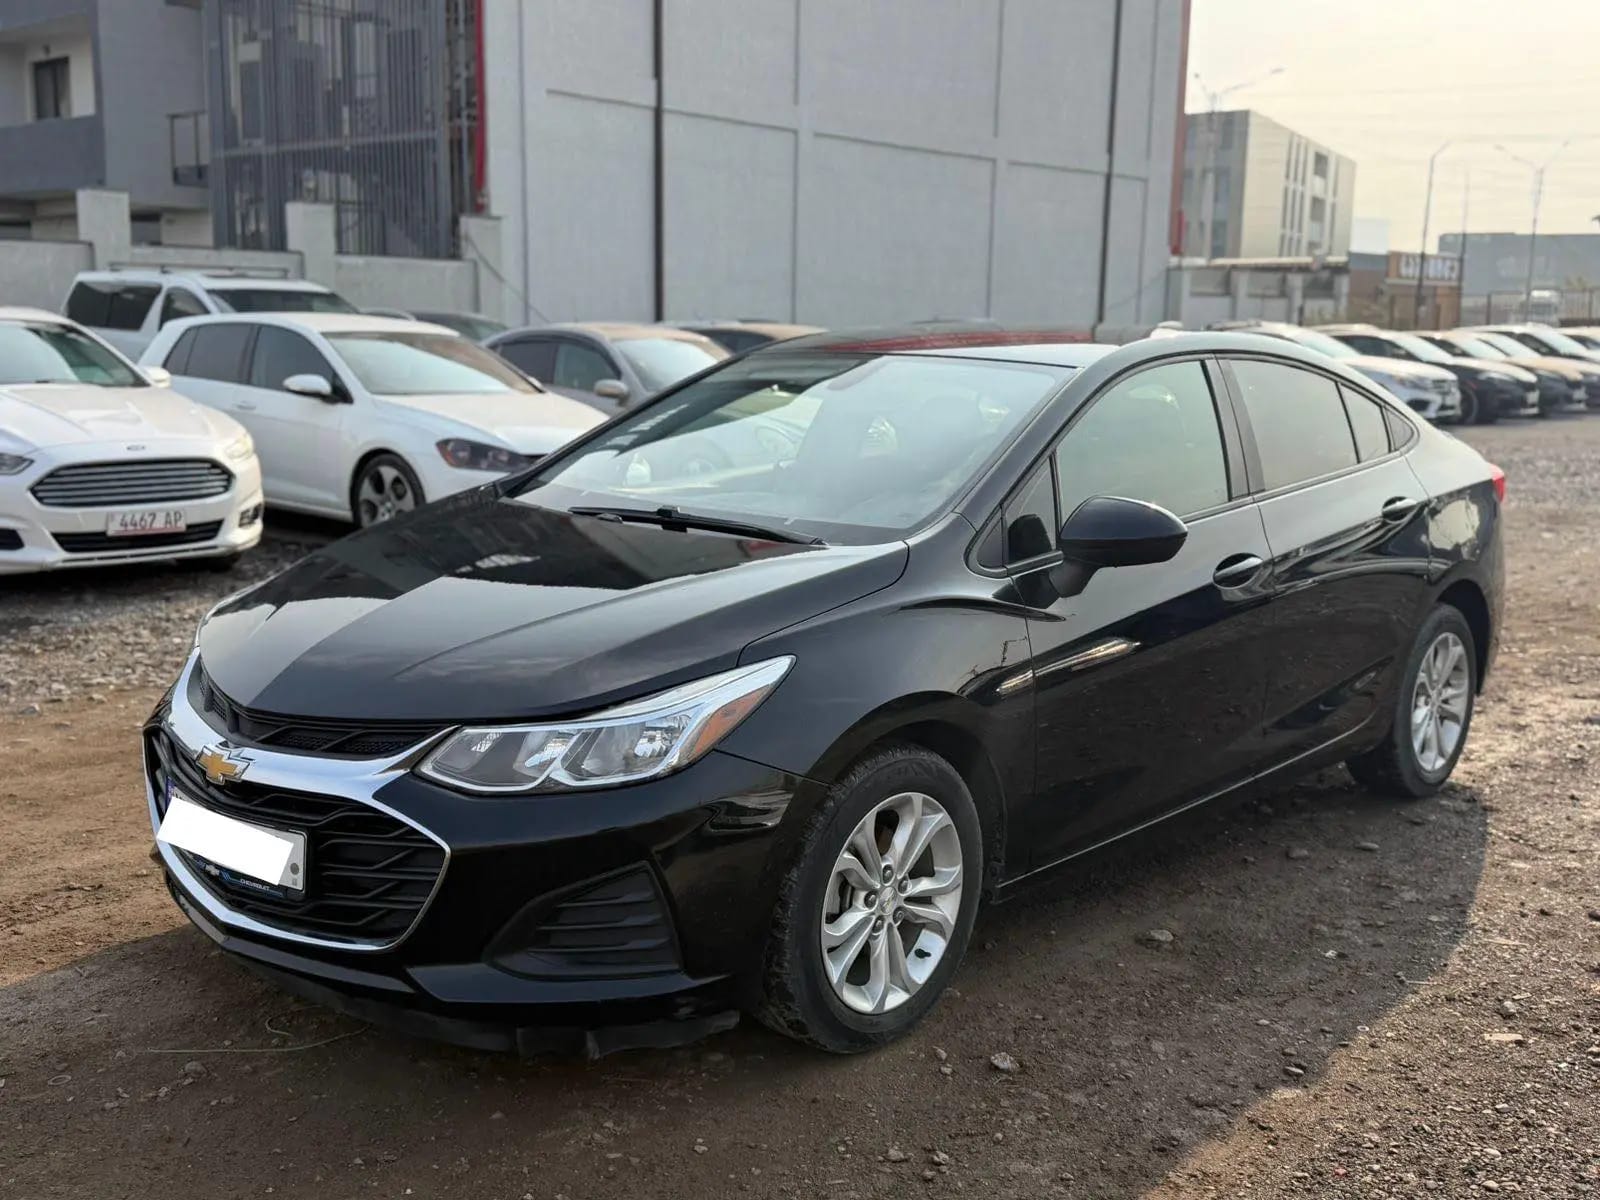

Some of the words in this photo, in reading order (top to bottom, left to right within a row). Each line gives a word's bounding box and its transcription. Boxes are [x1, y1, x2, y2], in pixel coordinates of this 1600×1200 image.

[120, 512, 157, 530] 4467
[164, 511, 182, 528] AP
[240, 879, 271, 891] CHEVROLET
